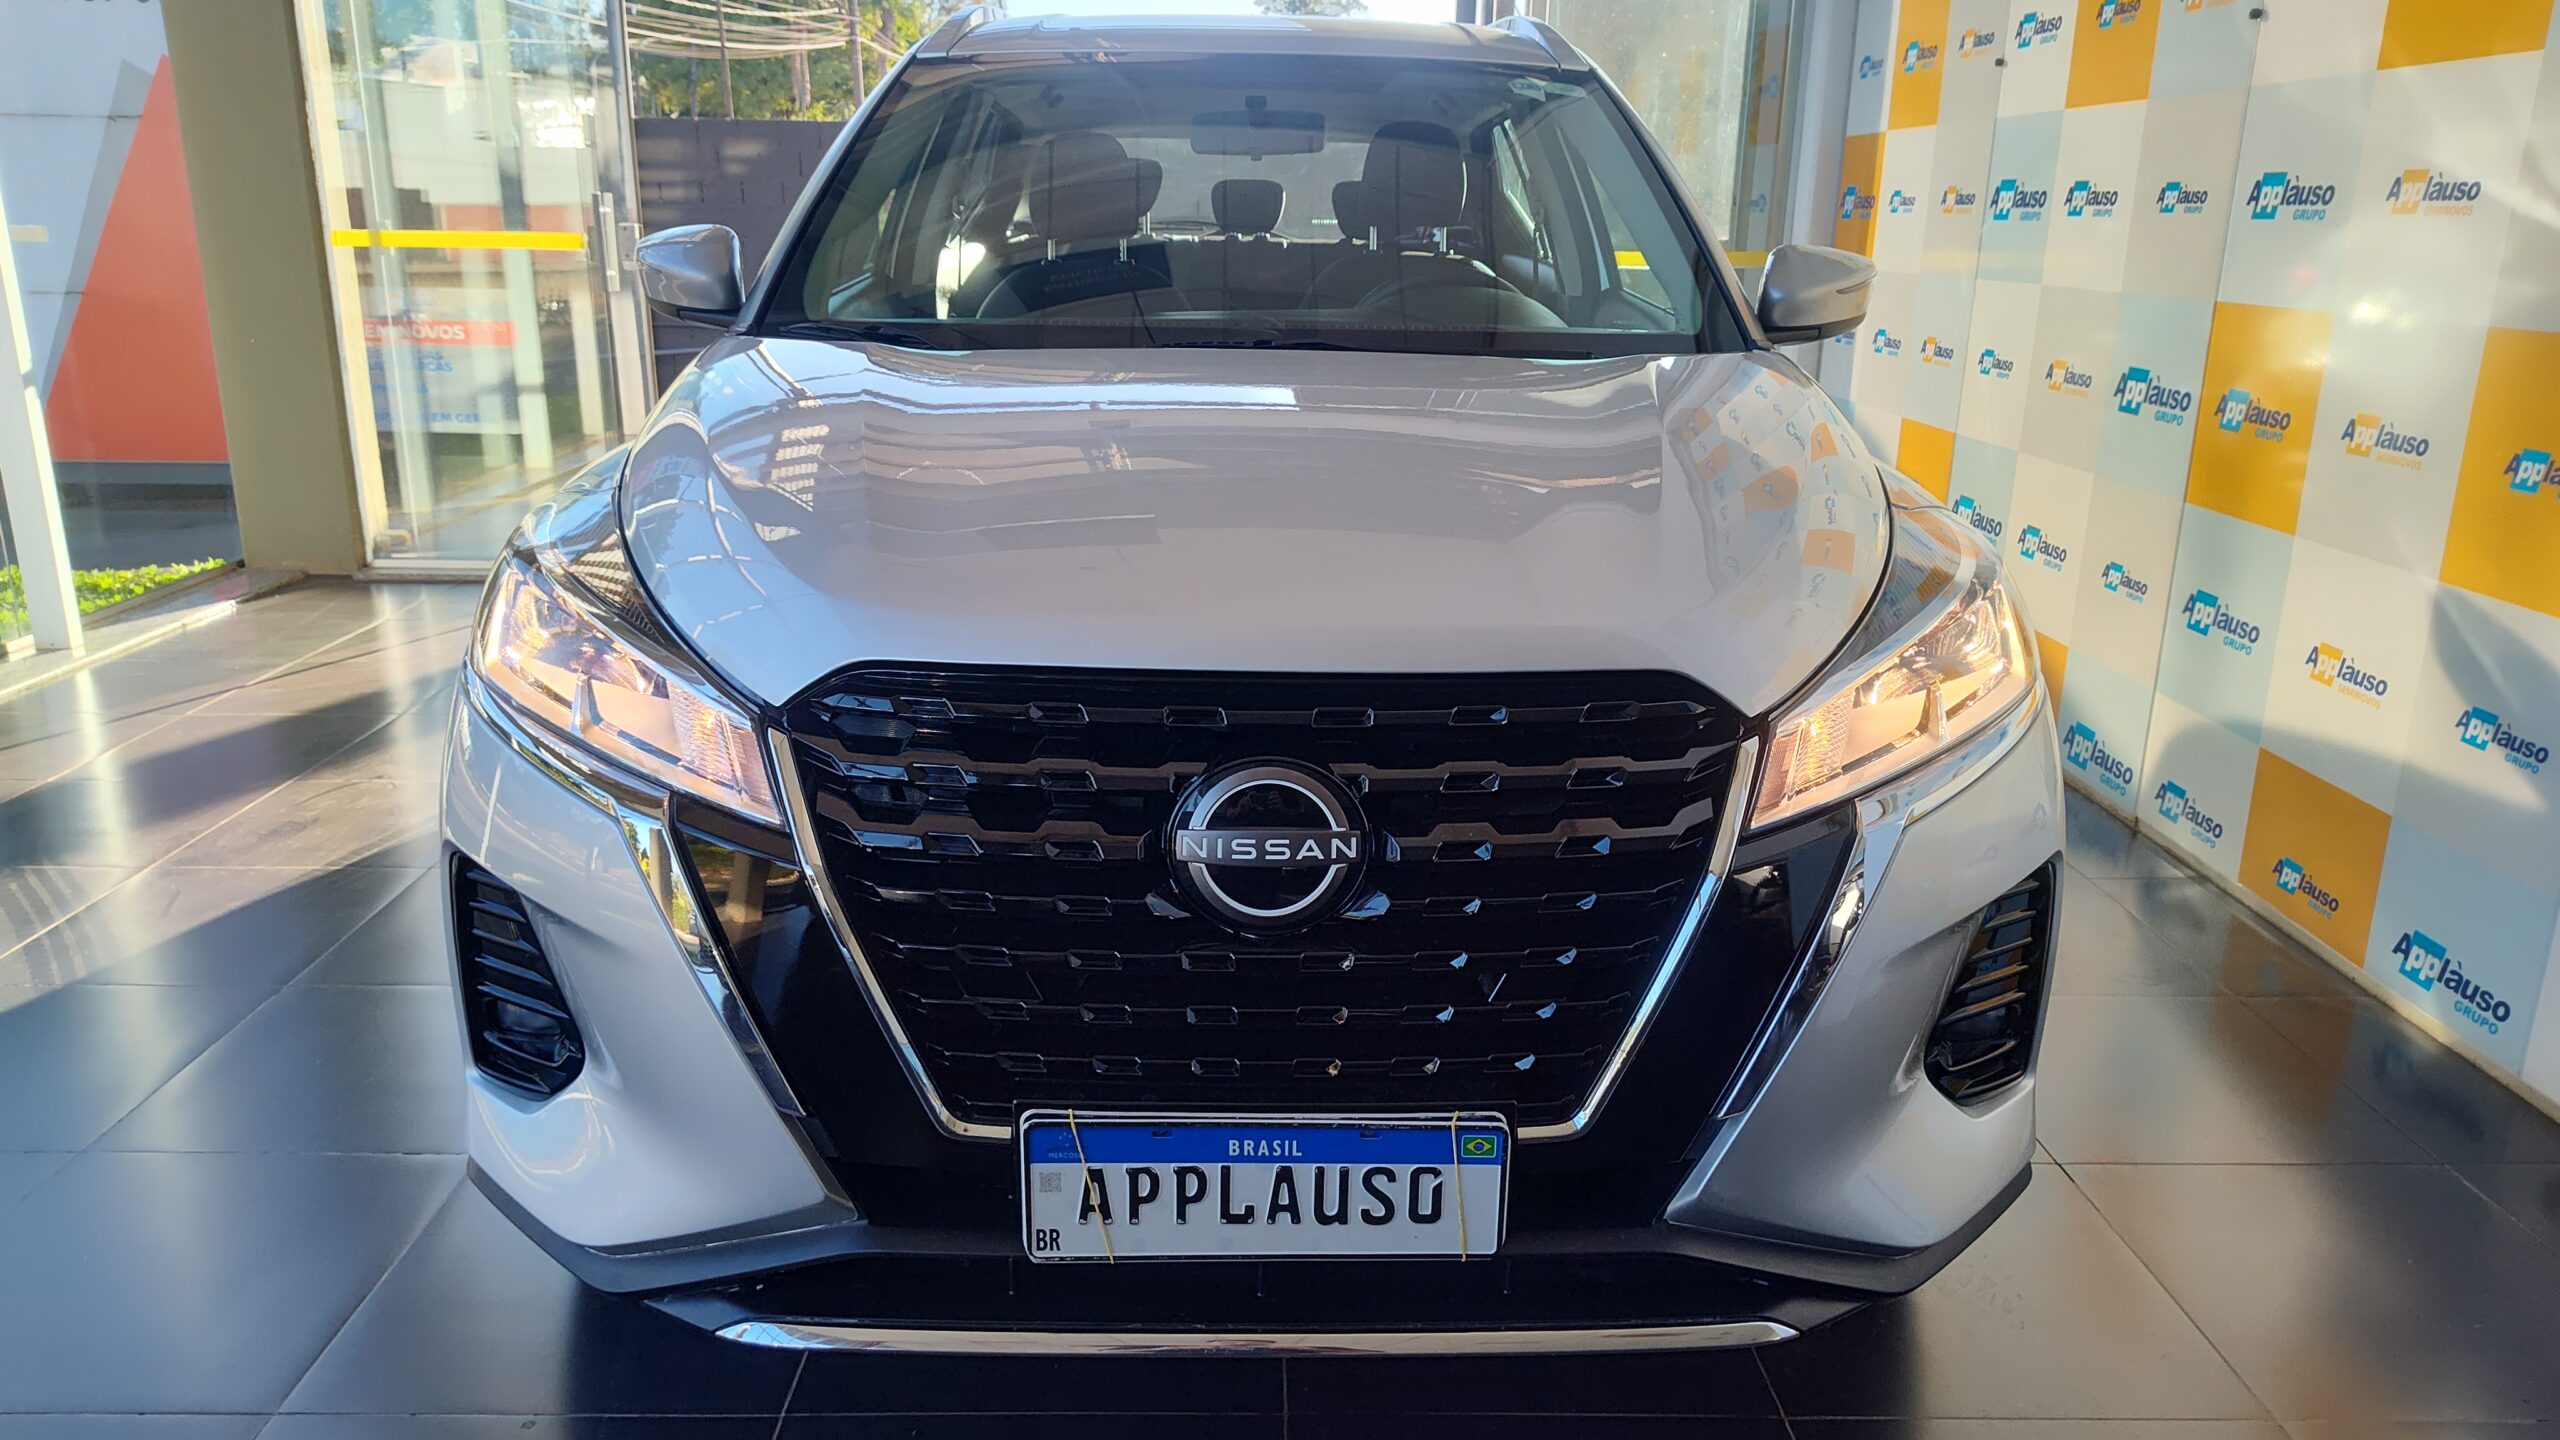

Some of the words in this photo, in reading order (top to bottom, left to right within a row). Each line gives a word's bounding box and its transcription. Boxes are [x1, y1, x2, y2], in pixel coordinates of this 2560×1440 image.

[2020, 211, 2041, 222] GRUPO
[2293, 208, 2326, 221] GRUPO
[2154, 410, 2184, 426] GRUPO
[2255, 428, 2283, 443] GRUPO
[2223, 636, 2252, 656] GRUPO
[2504, 752, 2540, 774] GRUPO
[2100, 772, 2127, 797] GRUPO
[1181, 836, 1357, 860] NISSAN
[2190, 826, 2217, 849] GRUPO
[2307, 899, 2333, 920] GRUPO
[2453, 1000, 2499, 1035] GRUPO
[1228, 1139, 1303, 1157] BRASIL
[1079, 1164, 1444, 1226] APPLAUSO
[1035, 1229, 1062, 1252] BR
